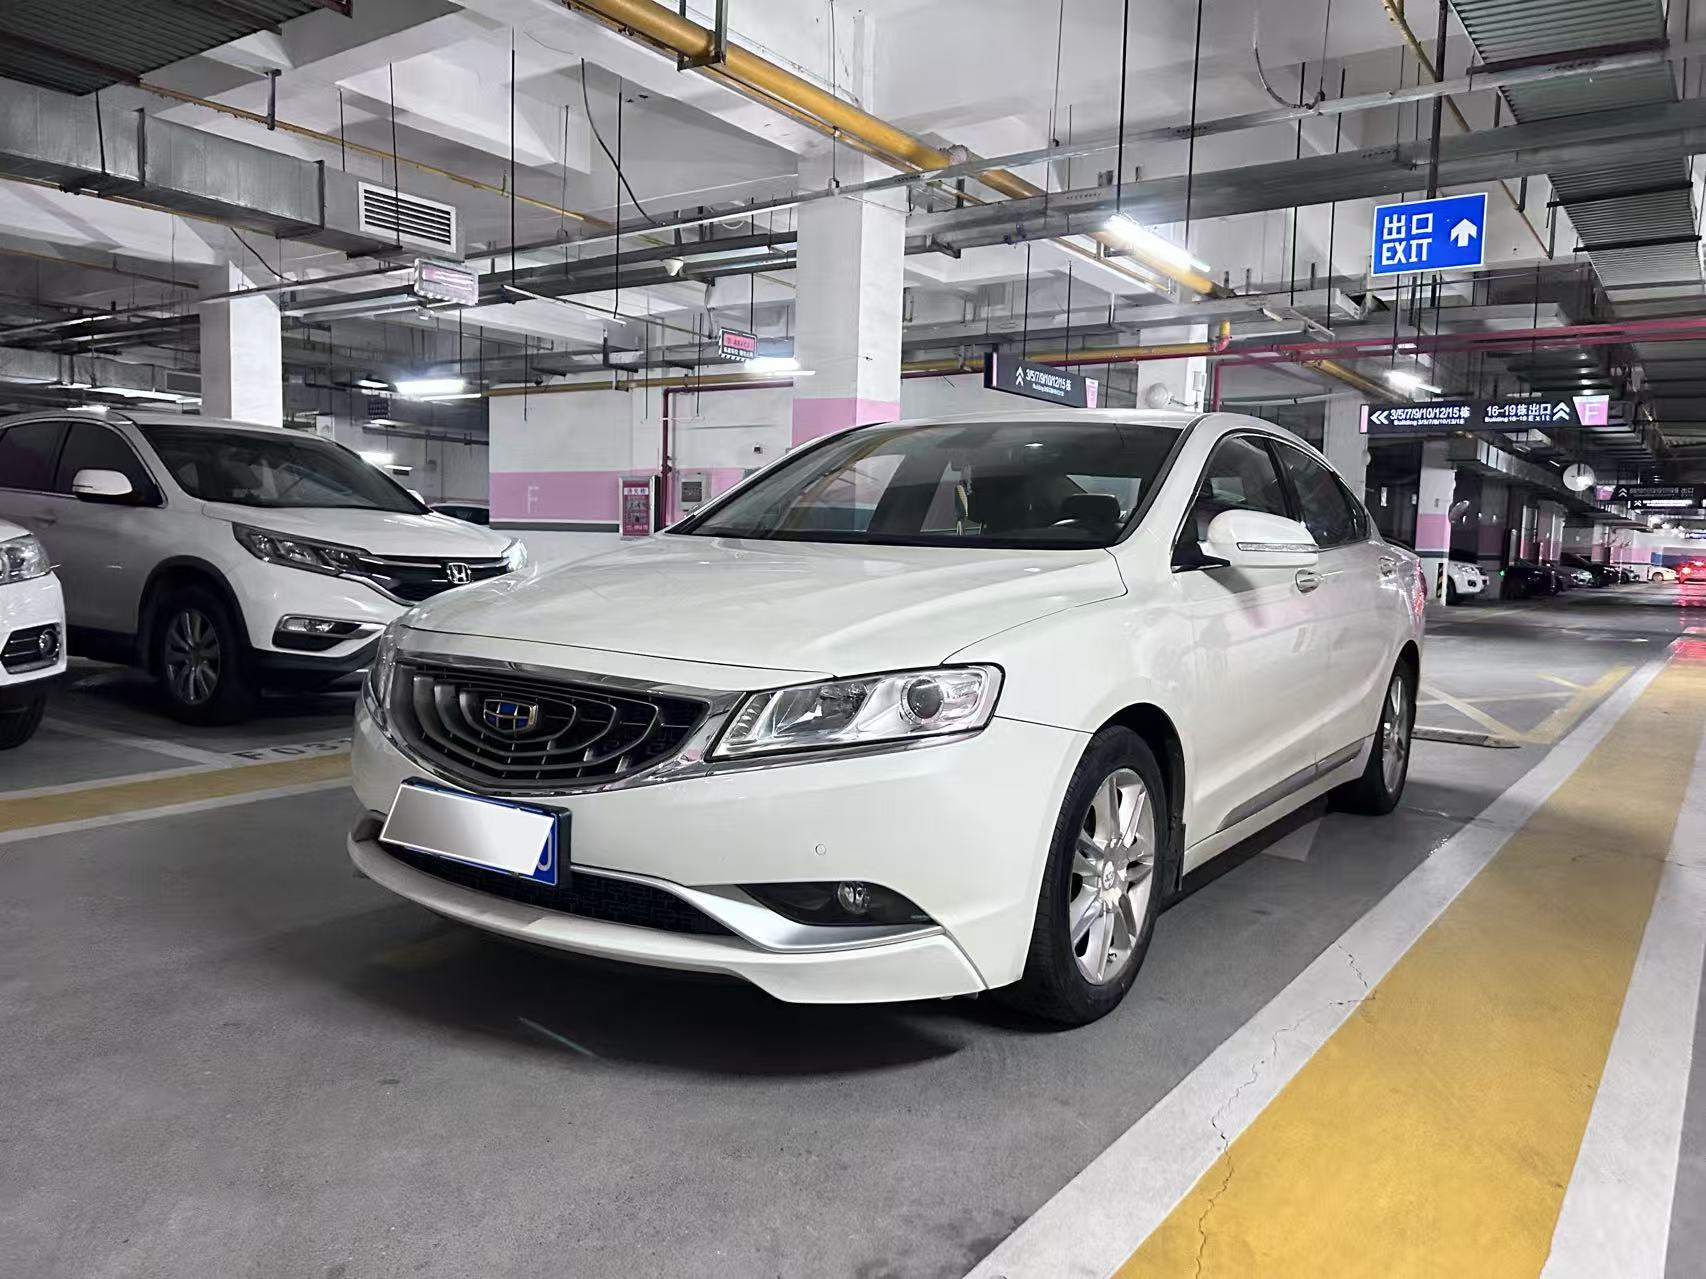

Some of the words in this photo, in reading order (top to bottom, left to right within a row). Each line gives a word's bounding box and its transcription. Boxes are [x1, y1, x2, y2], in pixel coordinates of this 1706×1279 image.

[1383, 213, 1433, 240] 出口
[1381, 238, 1432, 266] EXIT
[1585, 403, 1601, 424] F
